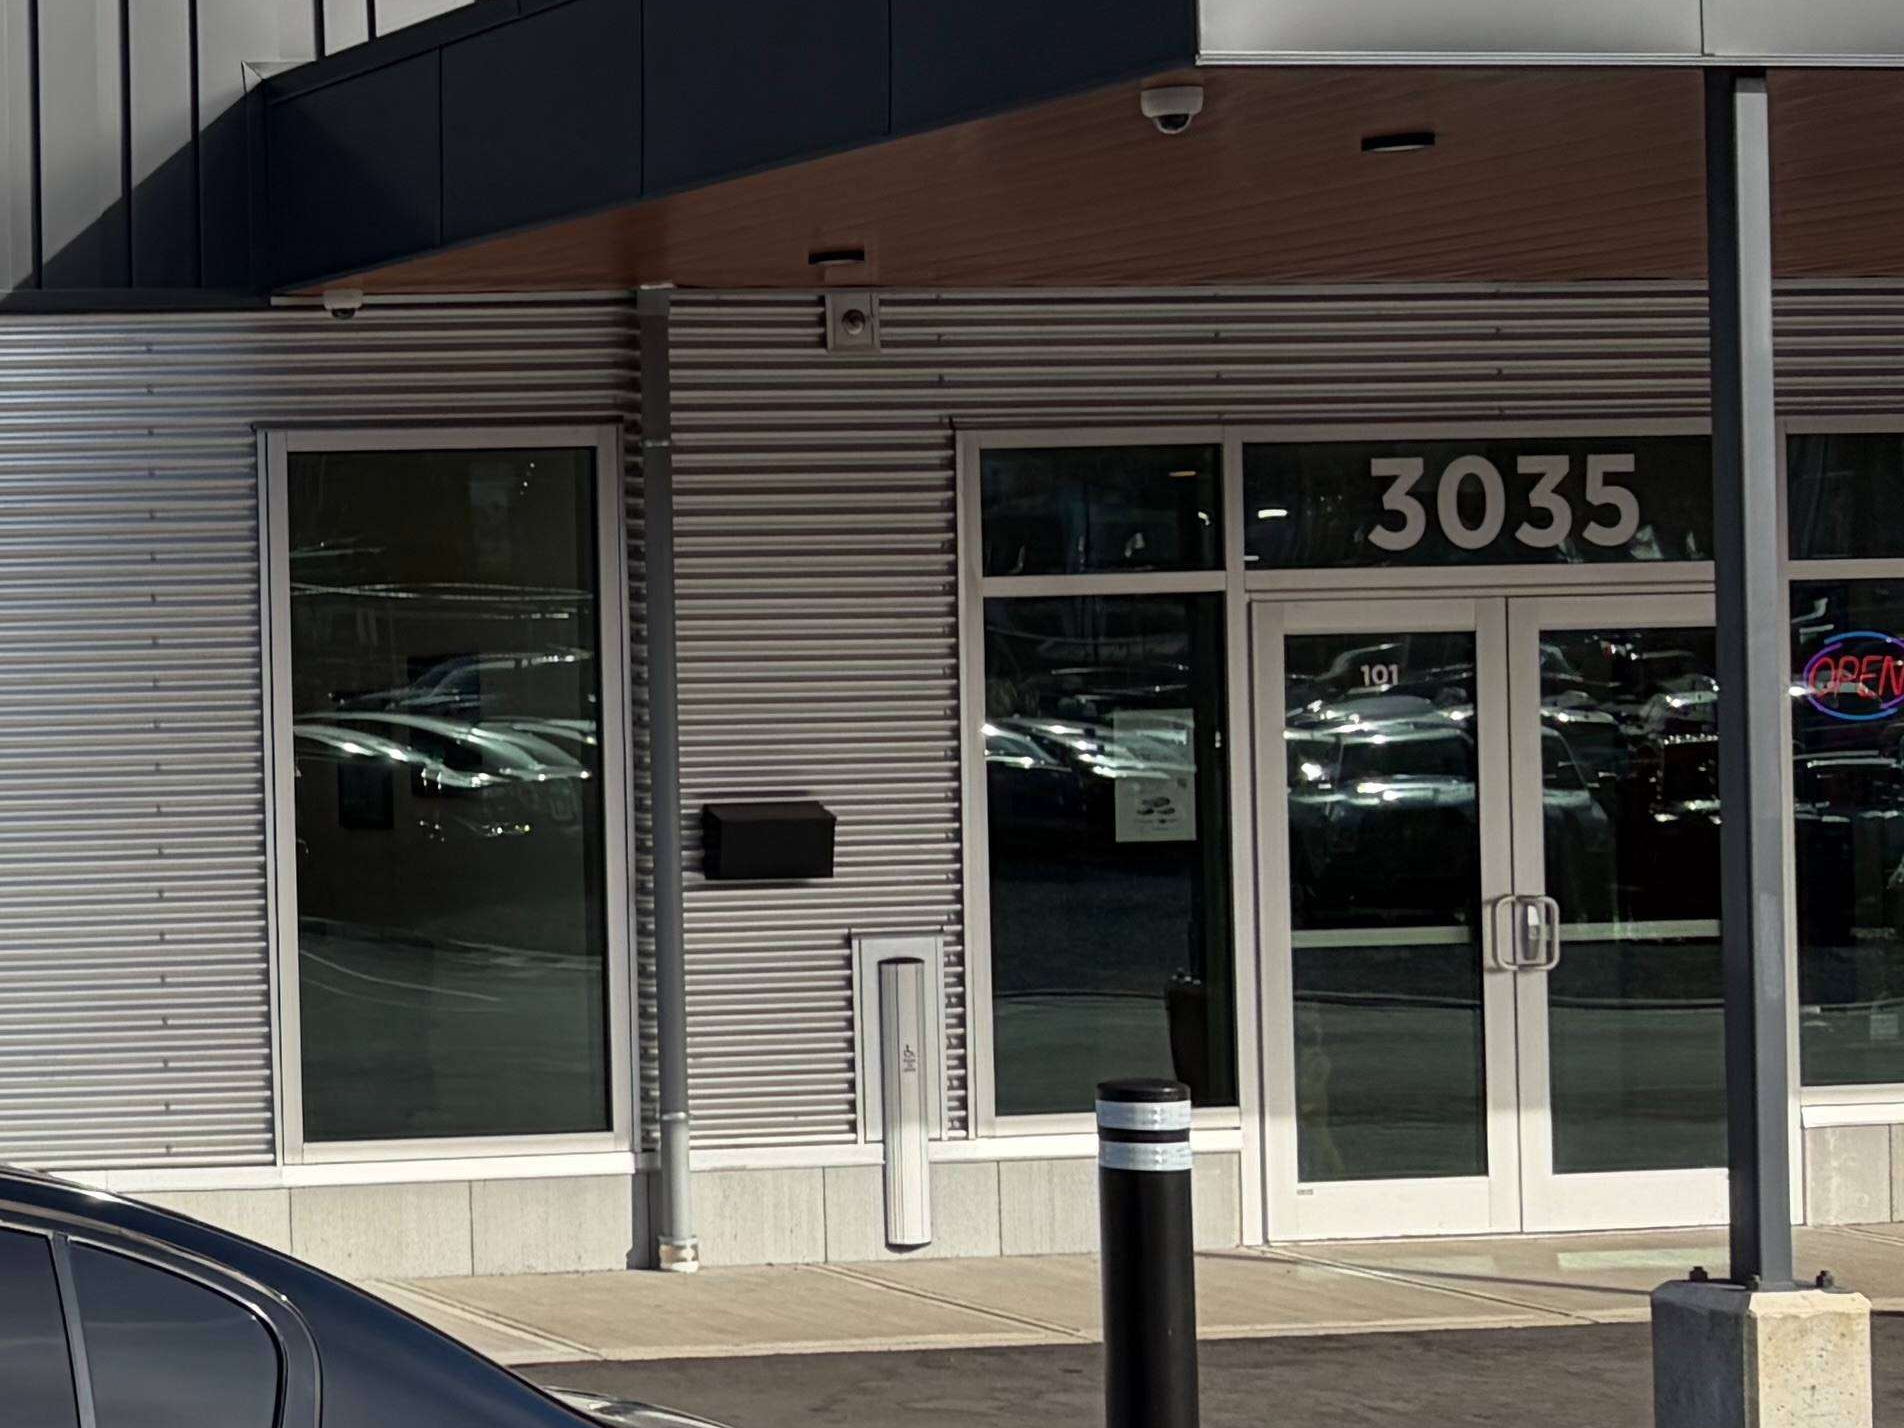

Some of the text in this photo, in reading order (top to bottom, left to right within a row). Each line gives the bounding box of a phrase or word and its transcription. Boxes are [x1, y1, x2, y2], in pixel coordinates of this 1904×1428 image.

[1368, 453, 1640, 551] 3035
[1360, 664, 1398, 686] 101
[1808, 655, 1904, 698] OPEN
